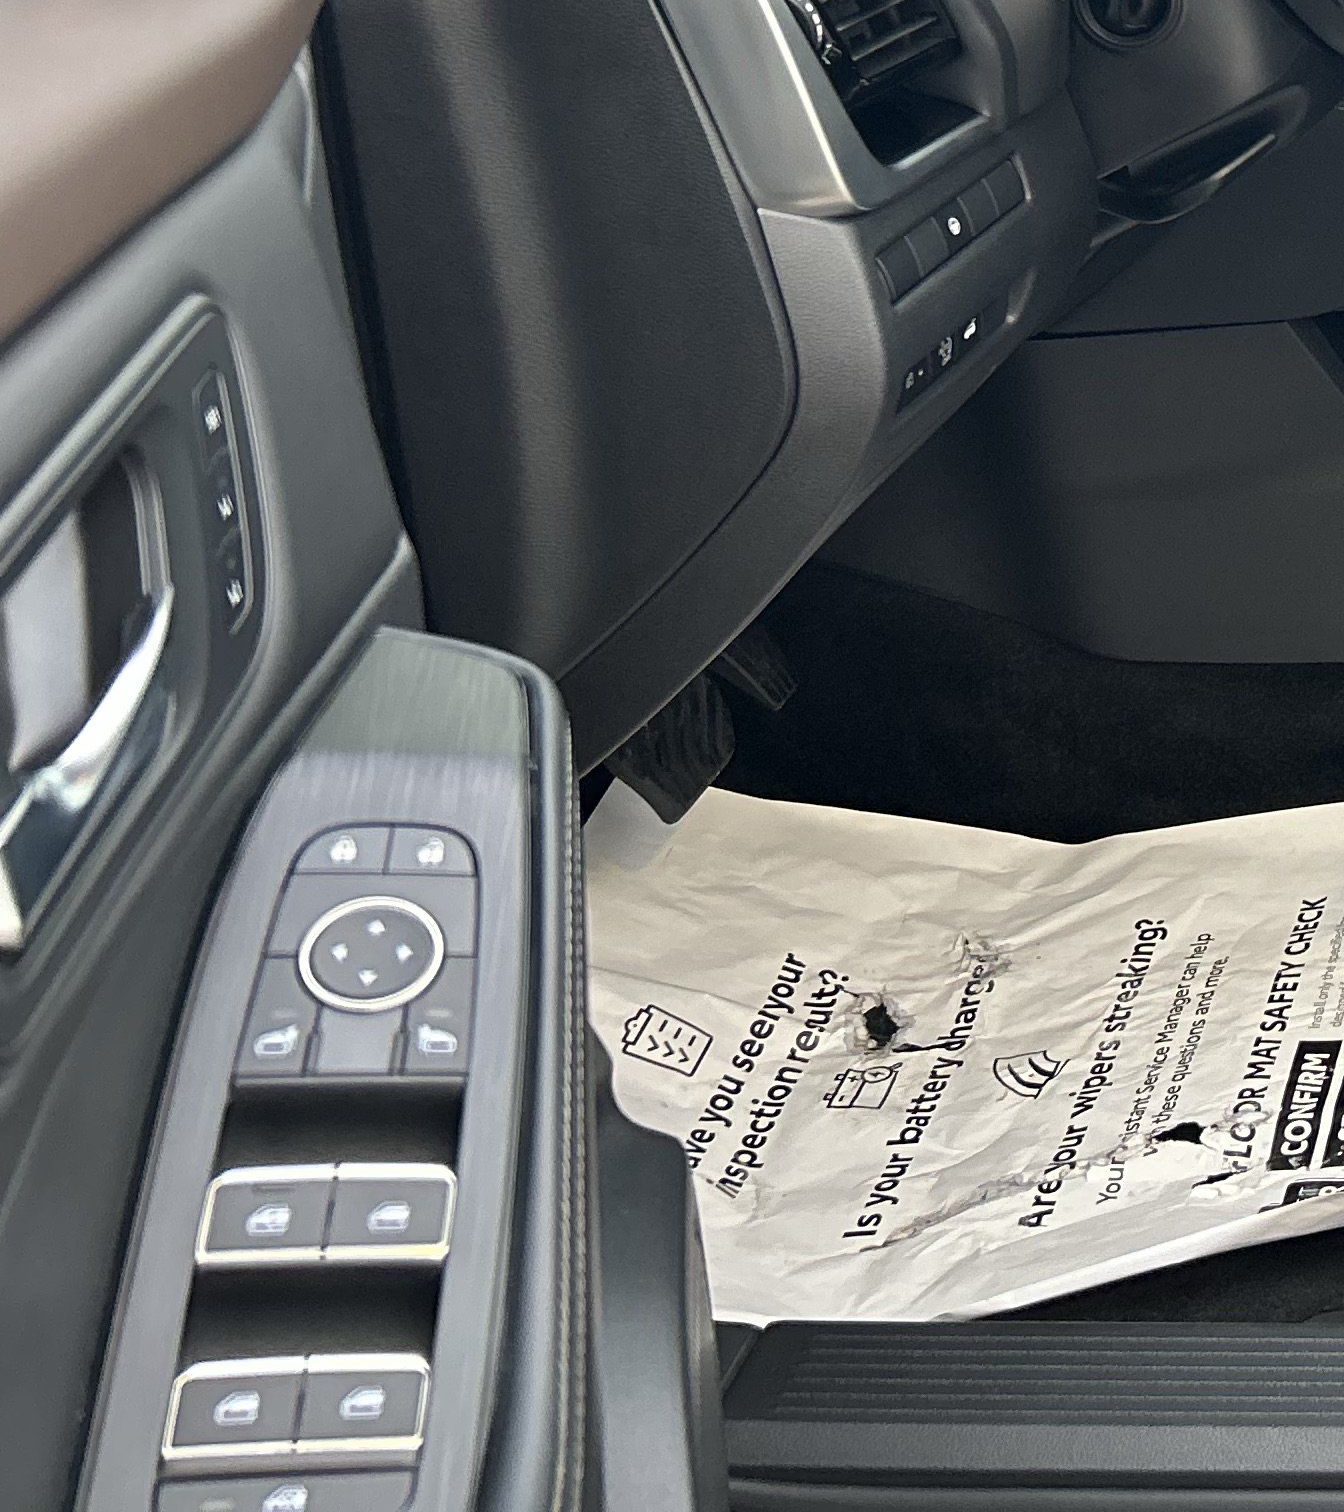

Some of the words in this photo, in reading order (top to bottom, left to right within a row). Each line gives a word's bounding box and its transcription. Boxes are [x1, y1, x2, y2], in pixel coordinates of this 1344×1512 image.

[1189, 933, 1216, 957] help
[1285, 896, 1328, 956] CHECK
[764, 953, 806, 1015] your
[1181, 956, 1198, 981] can
[1260, 961, 1305, 1033] SAFETY
[1154, 982, 1191, 1045] Manager
[1018, 1179, 1063, 1228] Are
[1043, 1125, 1088, 1178] your
[1069, 1040, 1121, 1119] wipers
[1103, 919, 1168, 1032] streaking?
[1136, 1047, 1167, 1096] Service
[1152, 1078, 1181, 1125] these
[1172, 1019, 1206, 1082] questions
[1196, 988, 1215, 1015] and
[1244, 1036, 1282, 1080] MAT
[699, 1074, 745, 1128] you
[886, 1057, 963, 1146] battery
[1281, 1052, 1330, 1156] CONFIRM
[685, 1128, 716, 1169] ave
[706, 1066, 803, 1199] inspection
[864, 1153, 914, 1208] your
[1096, 1155, 1125, 1205] Your
[842, 1213, 882, 1238] Is
